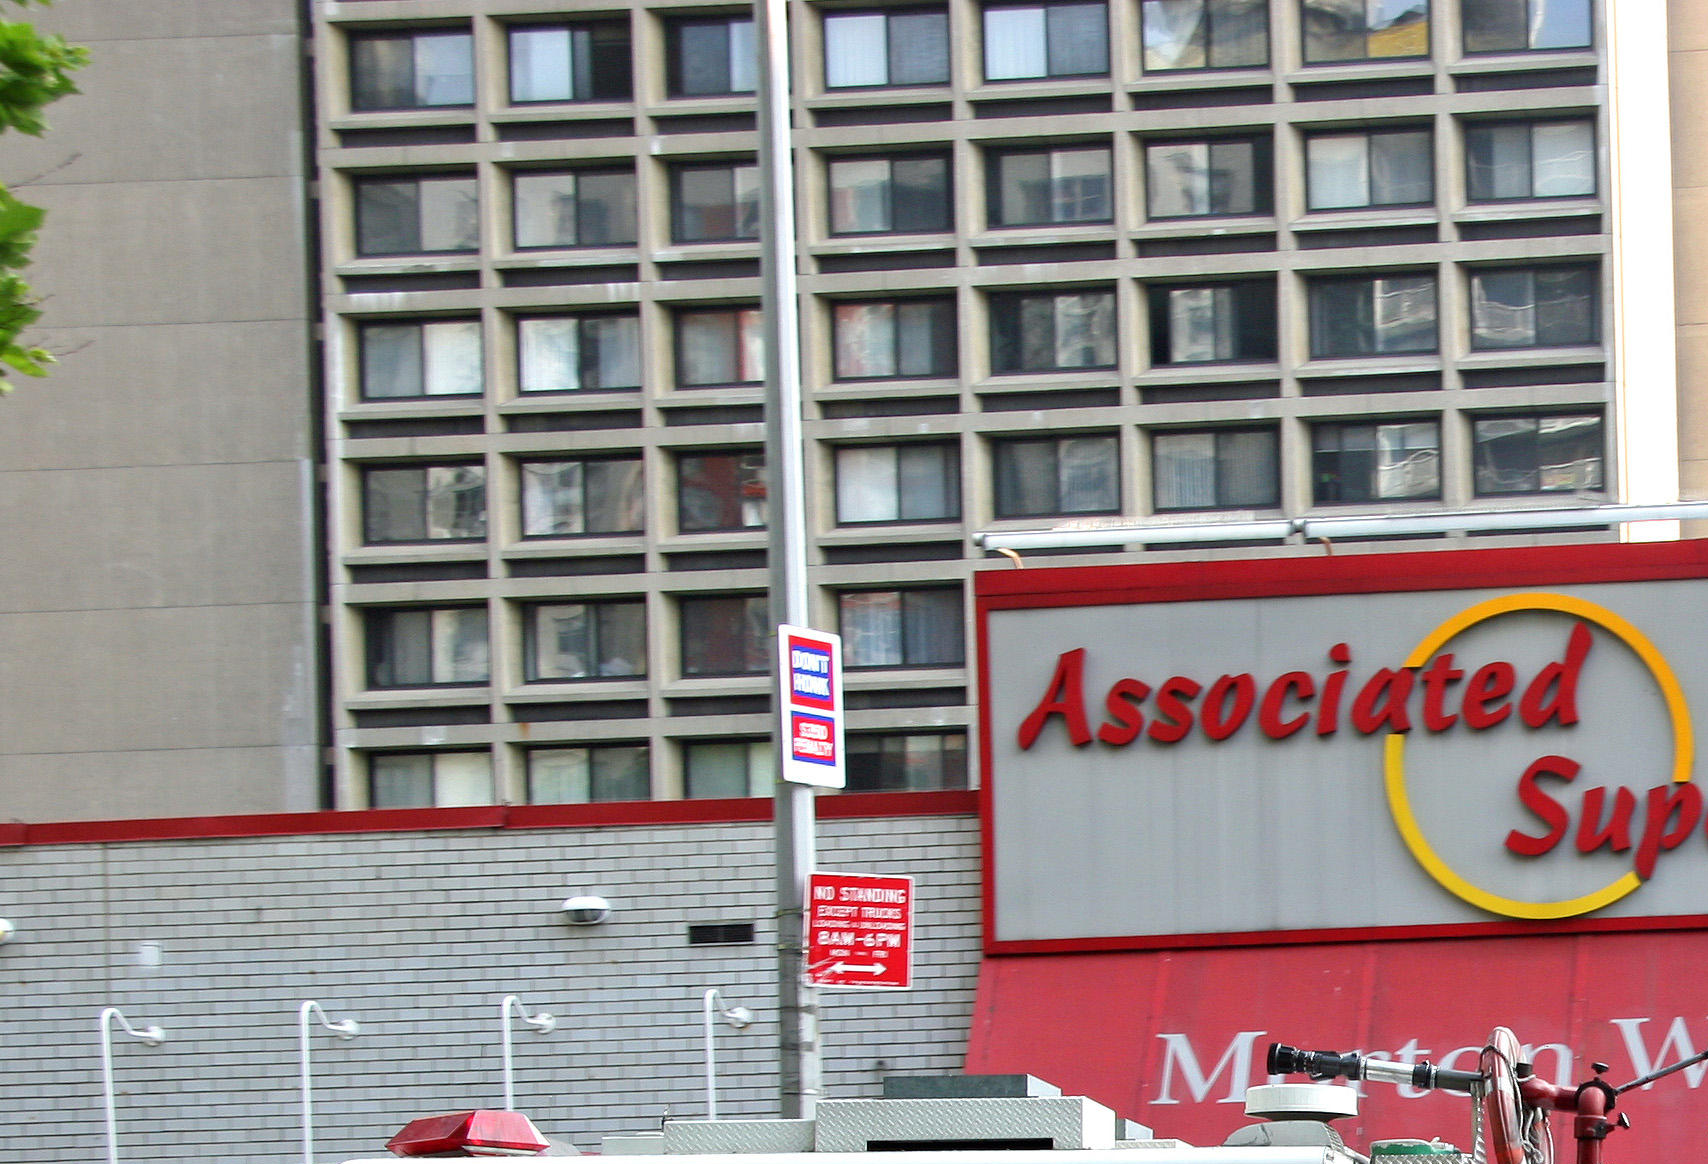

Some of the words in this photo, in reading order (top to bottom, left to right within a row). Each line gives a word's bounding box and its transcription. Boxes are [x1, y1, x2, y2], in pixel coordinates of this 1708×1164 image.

[1018, 620, 1594, 750] Associated
[814, 886, 836, 901] NO
[839, 886, 907, 904] STANDING
[1151, 1031, 1574, 1104] Mrtn
